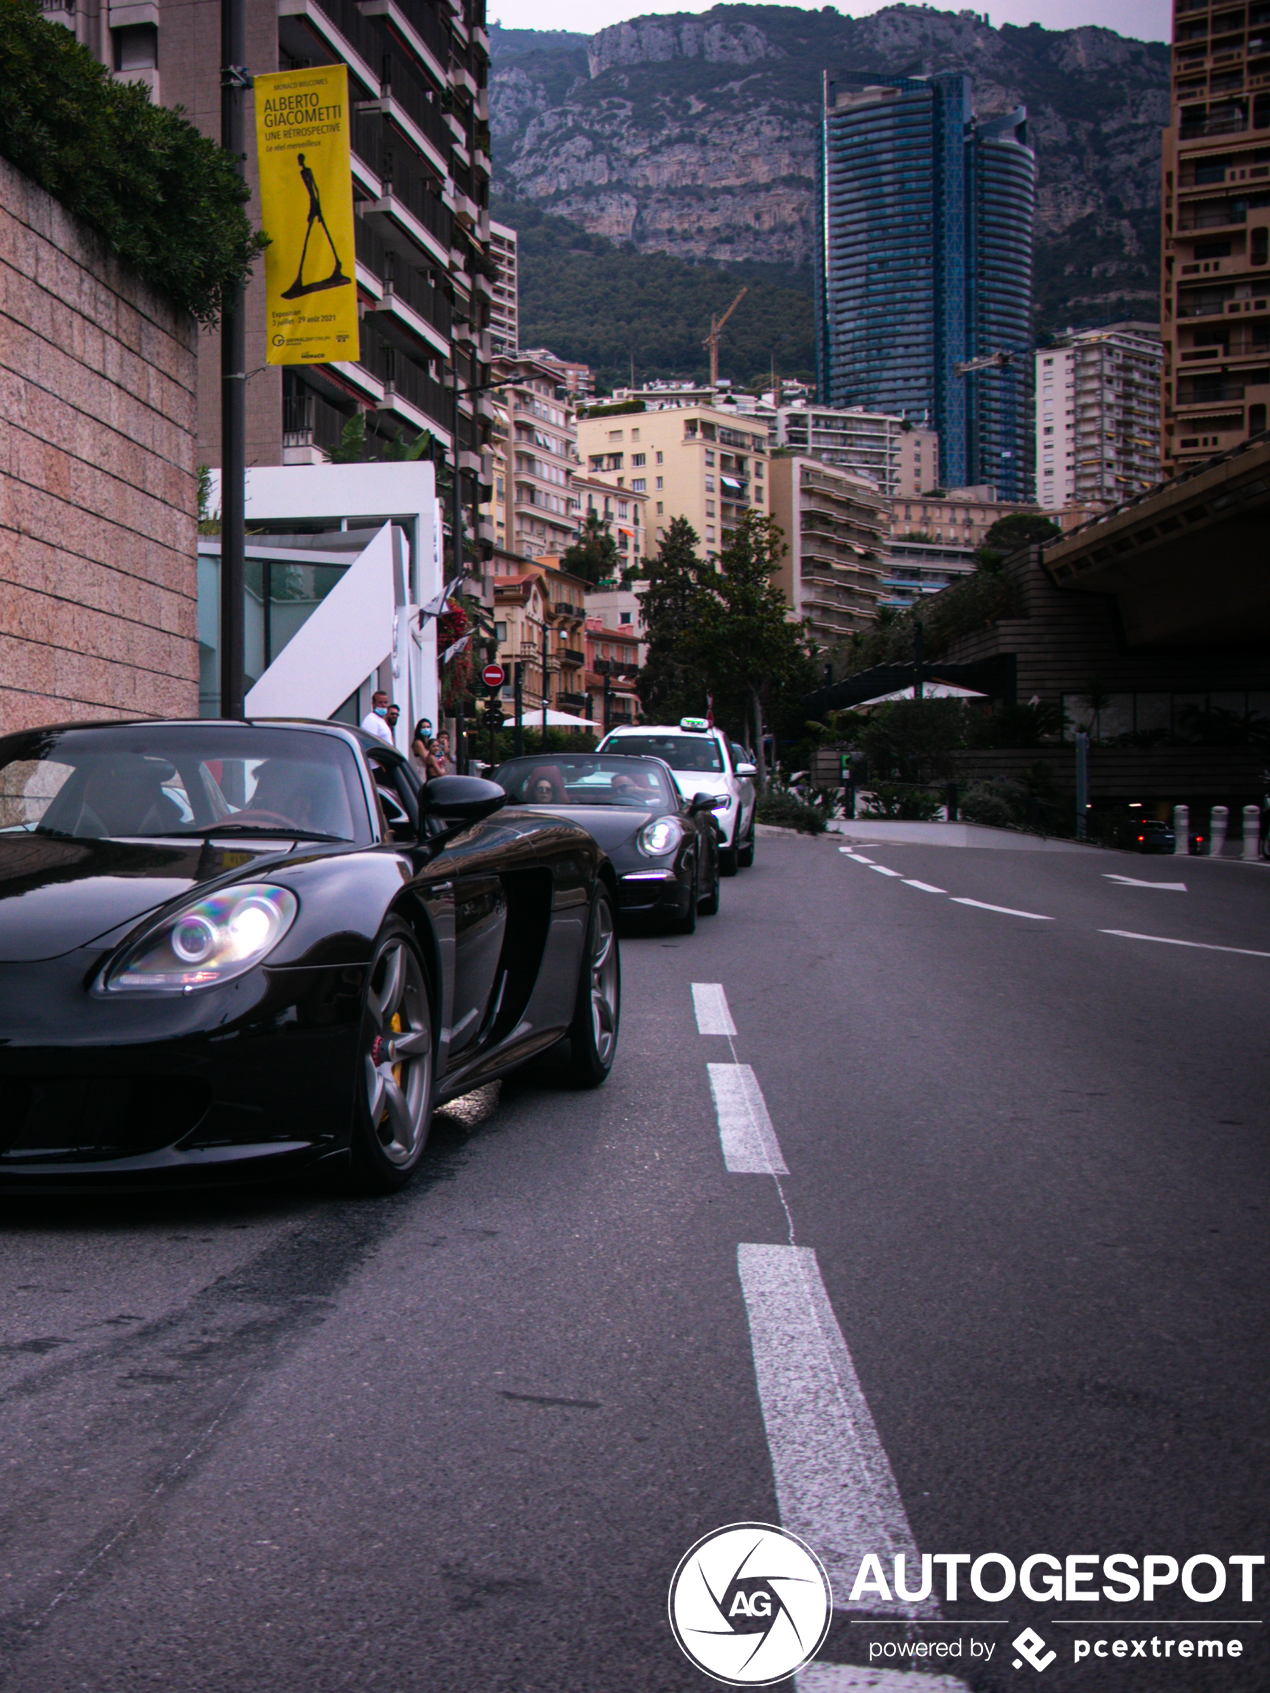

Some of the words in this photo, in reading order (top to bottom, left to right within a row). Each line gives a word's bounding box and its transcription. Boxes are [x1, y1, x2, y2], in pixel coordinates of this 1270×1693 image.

[274, 82, 298, 90] MONACO
[299, 78, 328, 88] WELCOMES
[264, 93, 319, 112] ALBERTO
[264, 105, 341, 128] GIACOMETTI
[265, 131, 281, 141] UNE
[283, 123, 341, 139] RÉTROSPECTIVE
[266, 144, 273, 152] Le
[287, 140, 321, 150] merveilleux
[272, 310, 301, 318] Exposition
[277, 319, 294, 327] juillet
